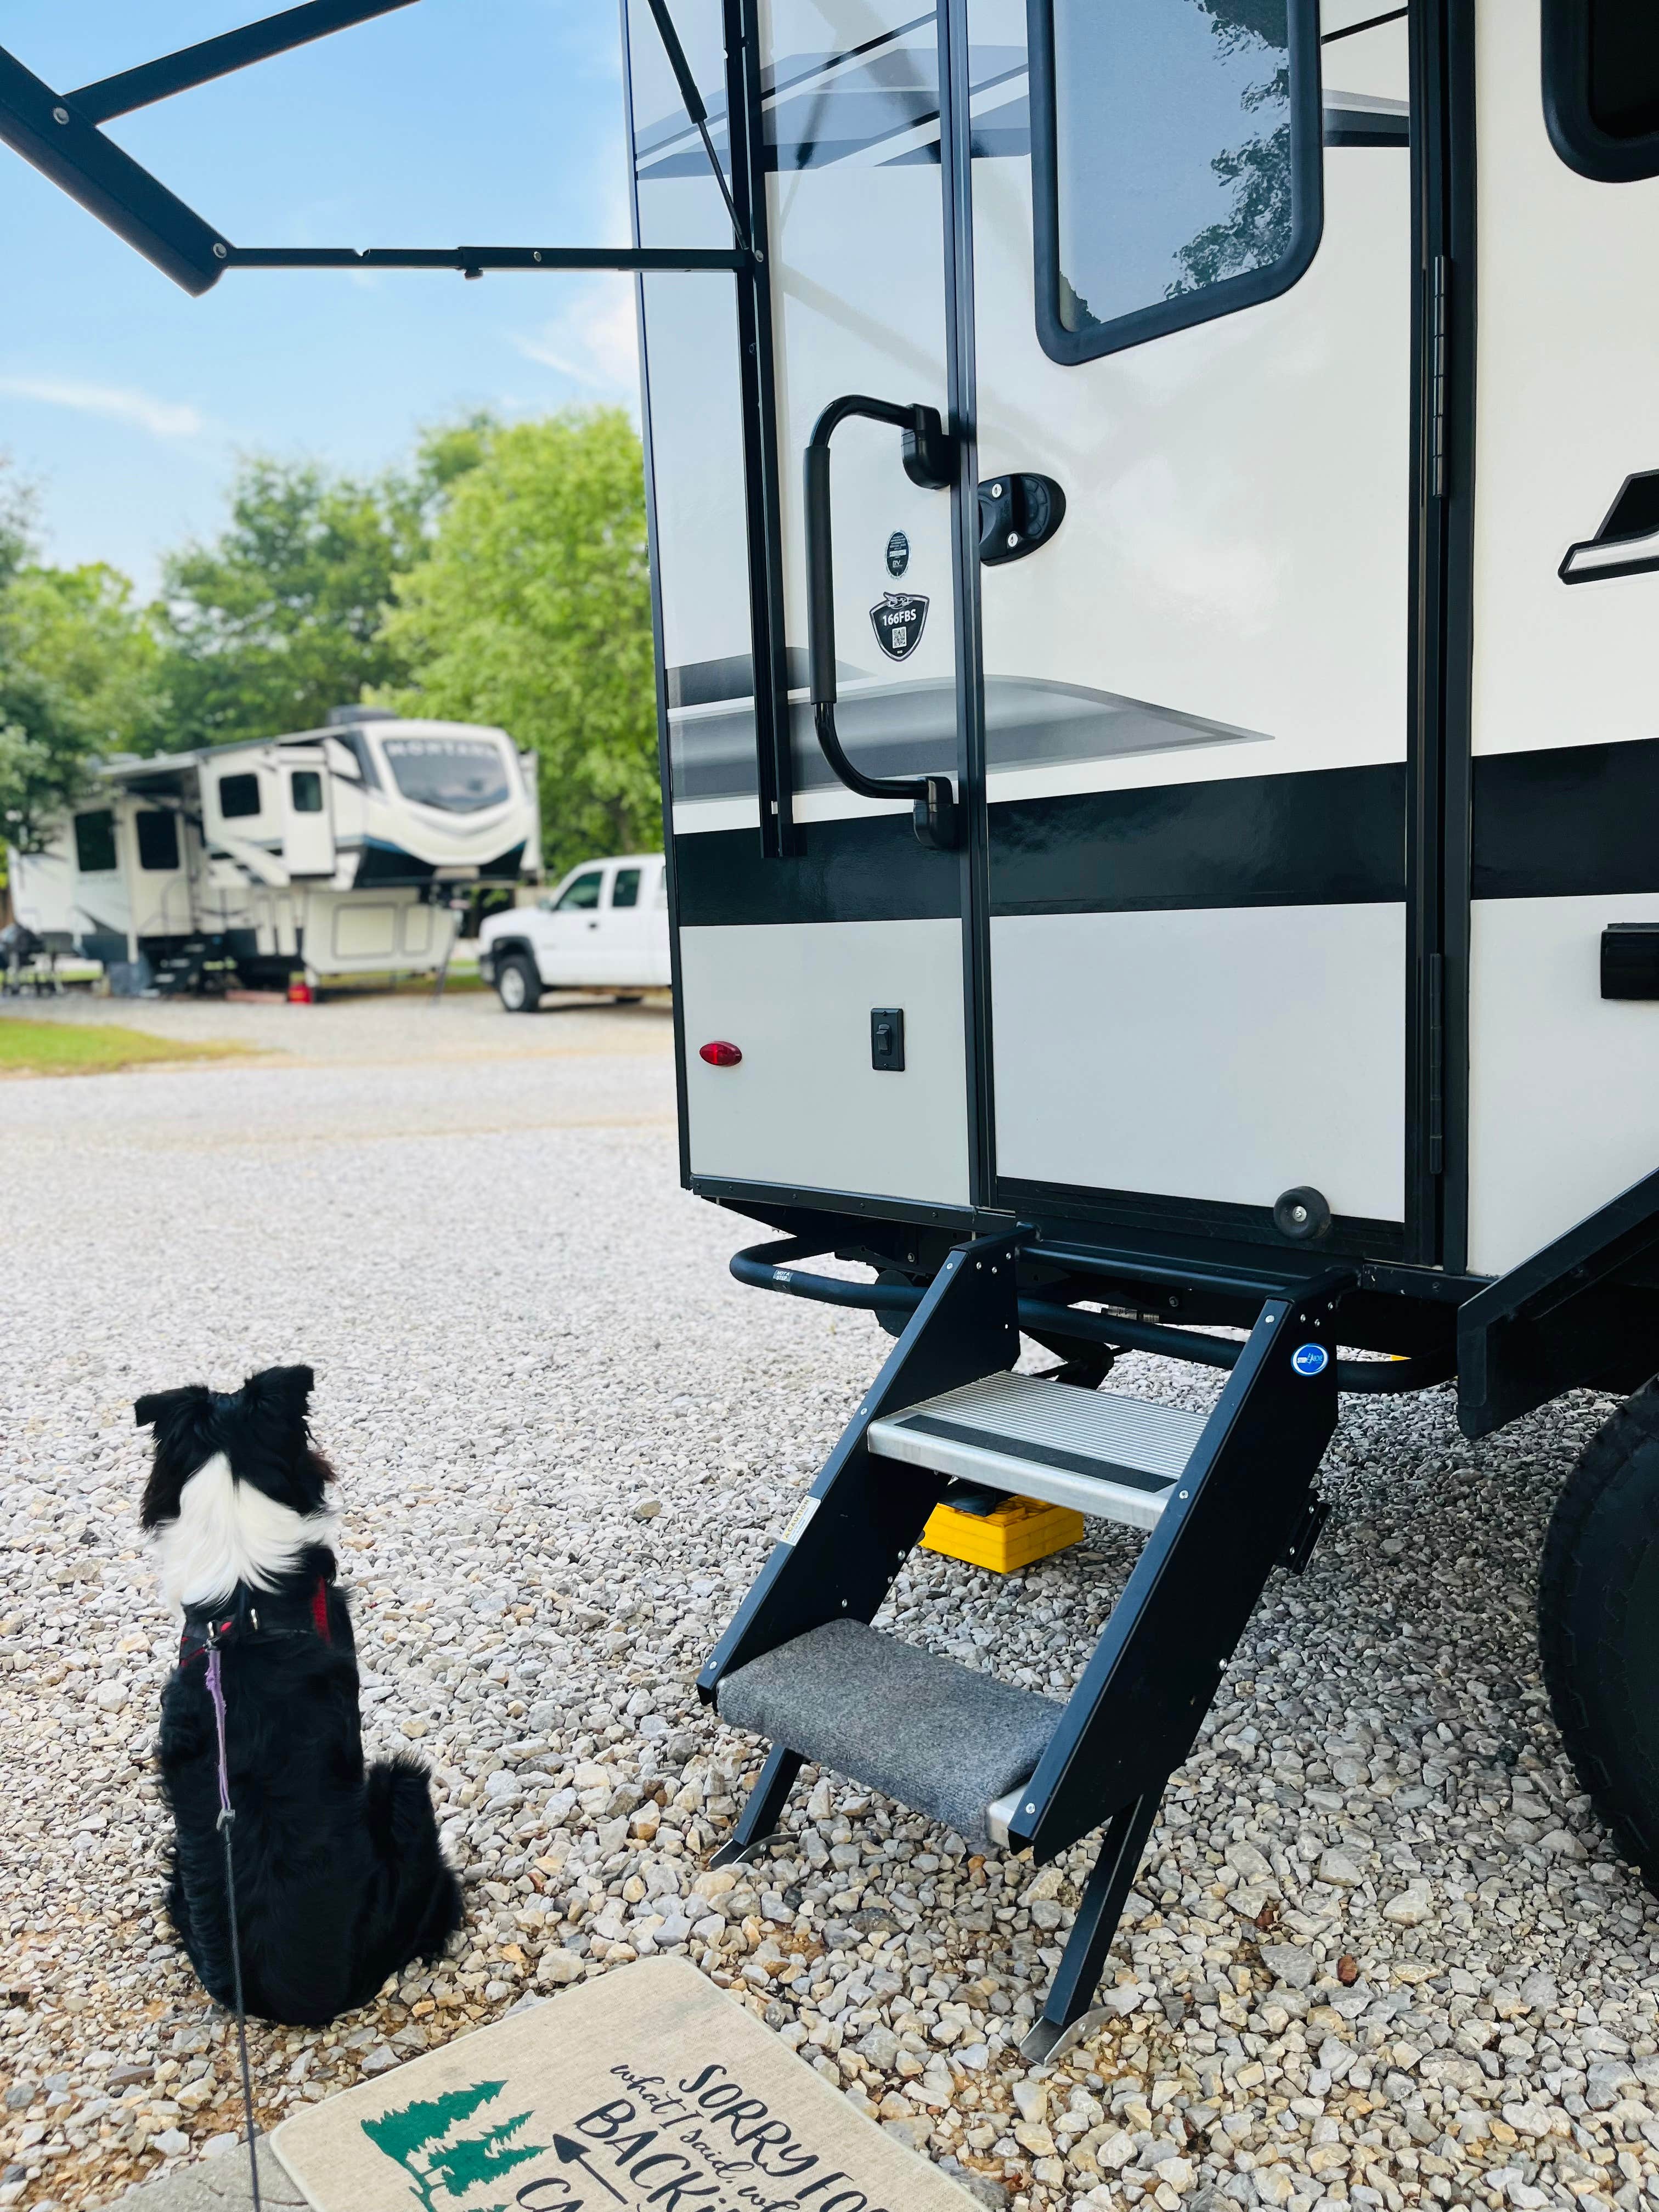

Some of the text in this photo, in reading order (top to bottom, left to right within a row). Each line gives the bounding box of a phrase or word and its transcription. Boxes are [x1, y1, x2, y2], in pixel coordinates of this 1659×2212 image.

[882, 609, 916, 626] 166FBS
[788, 1499, 809, 1532] CAUTION
[610, 2064, 687, 2113] what
[659, 2110, 704, 2130] I
[679, 2064, 890, 2212] SORRY FO
